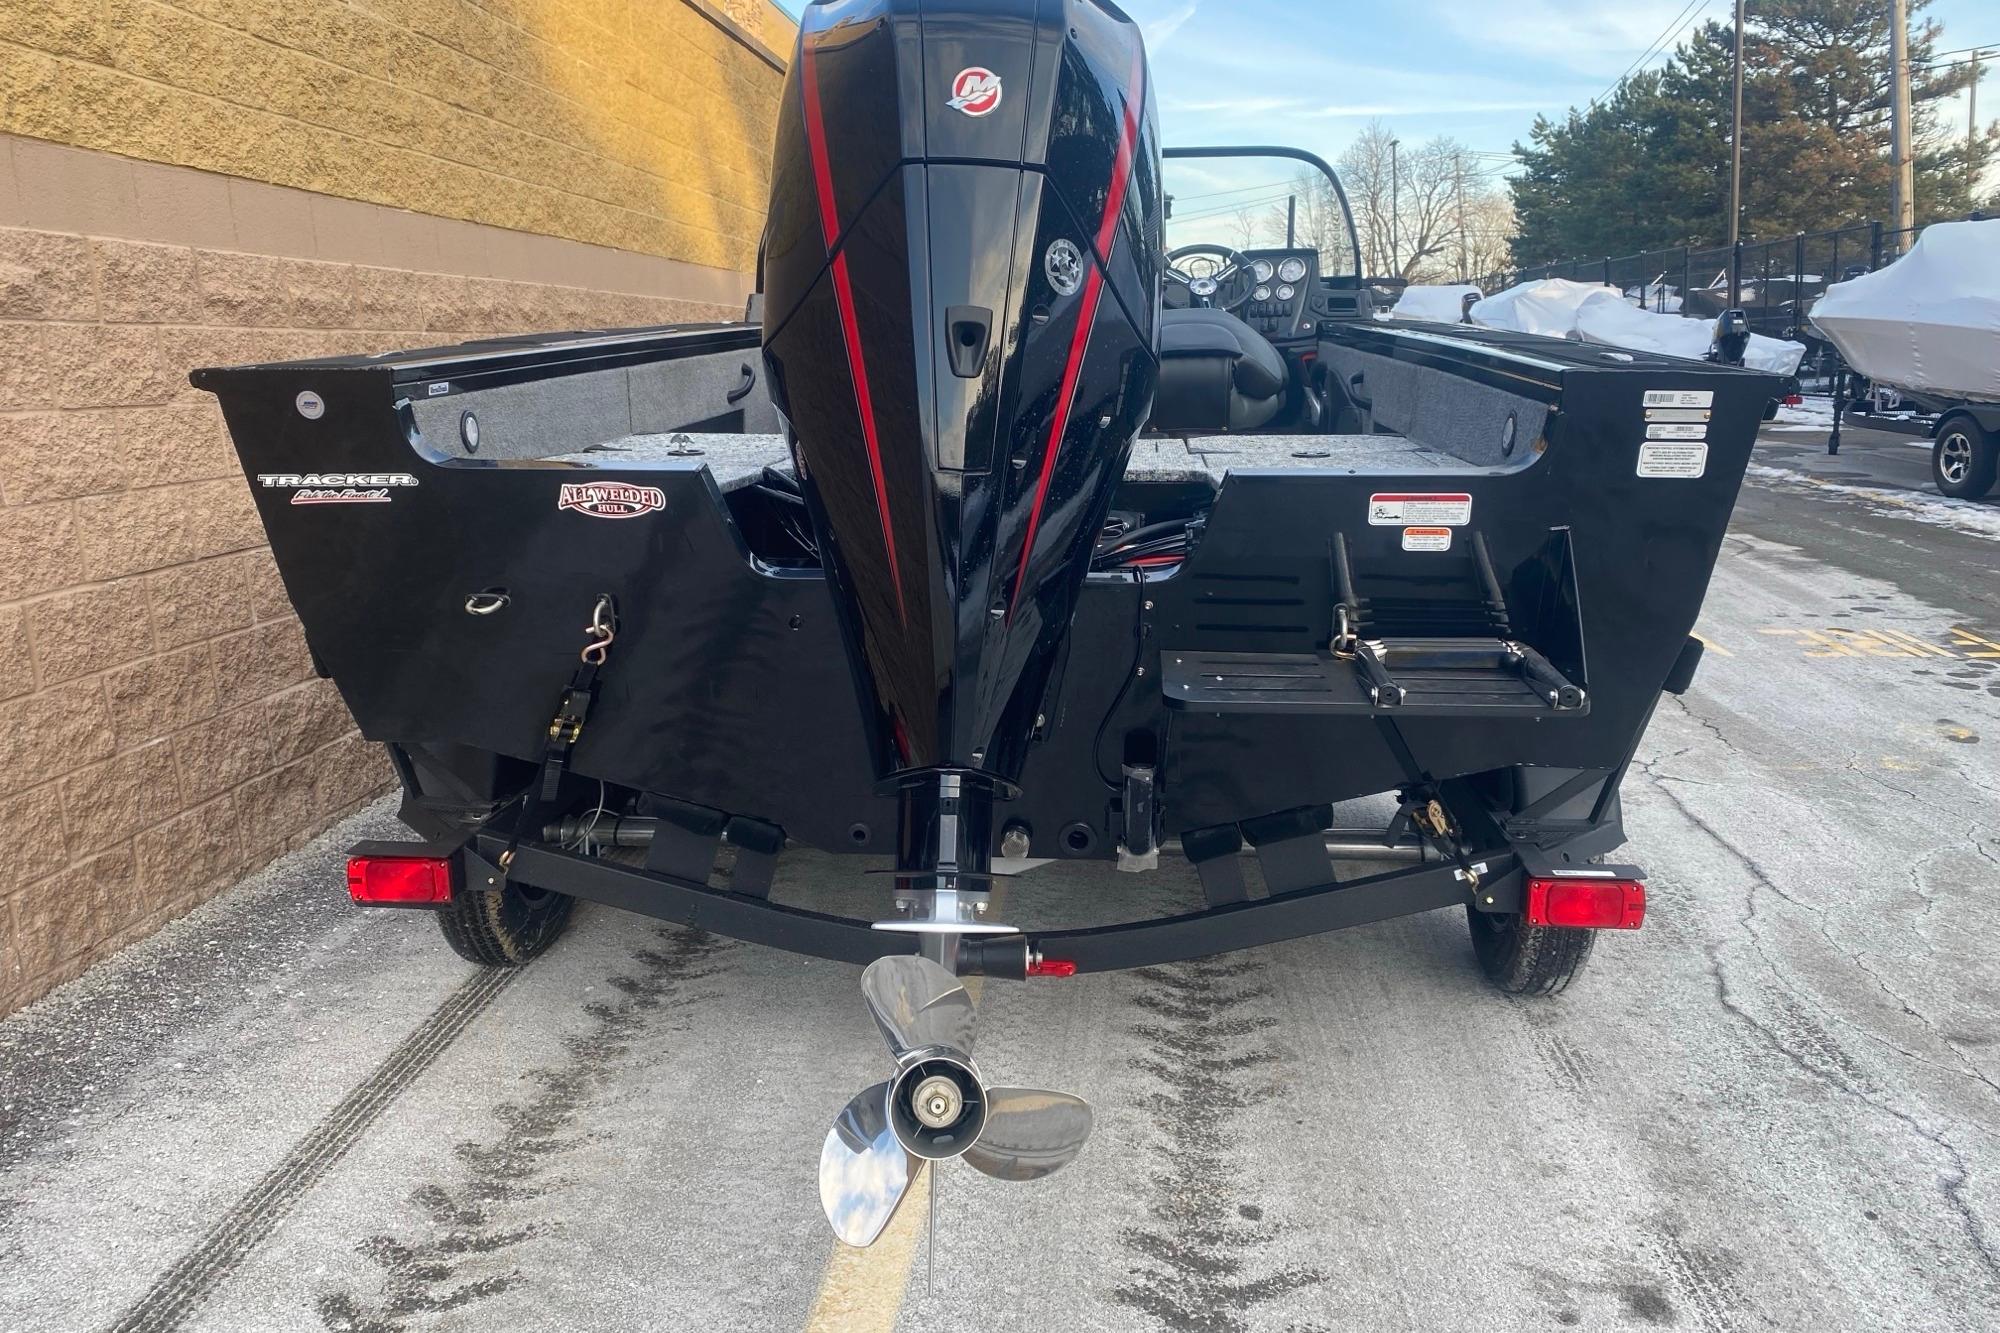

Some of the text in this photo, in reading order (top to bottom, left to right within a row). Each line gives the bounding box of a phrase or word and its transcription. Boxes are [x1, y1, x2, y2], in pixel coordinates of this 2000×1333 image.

[319, 490, 339, 499] the
[561, 486, 662, 507] ALL WELDED
[597, 504, 628, 513] HULL
